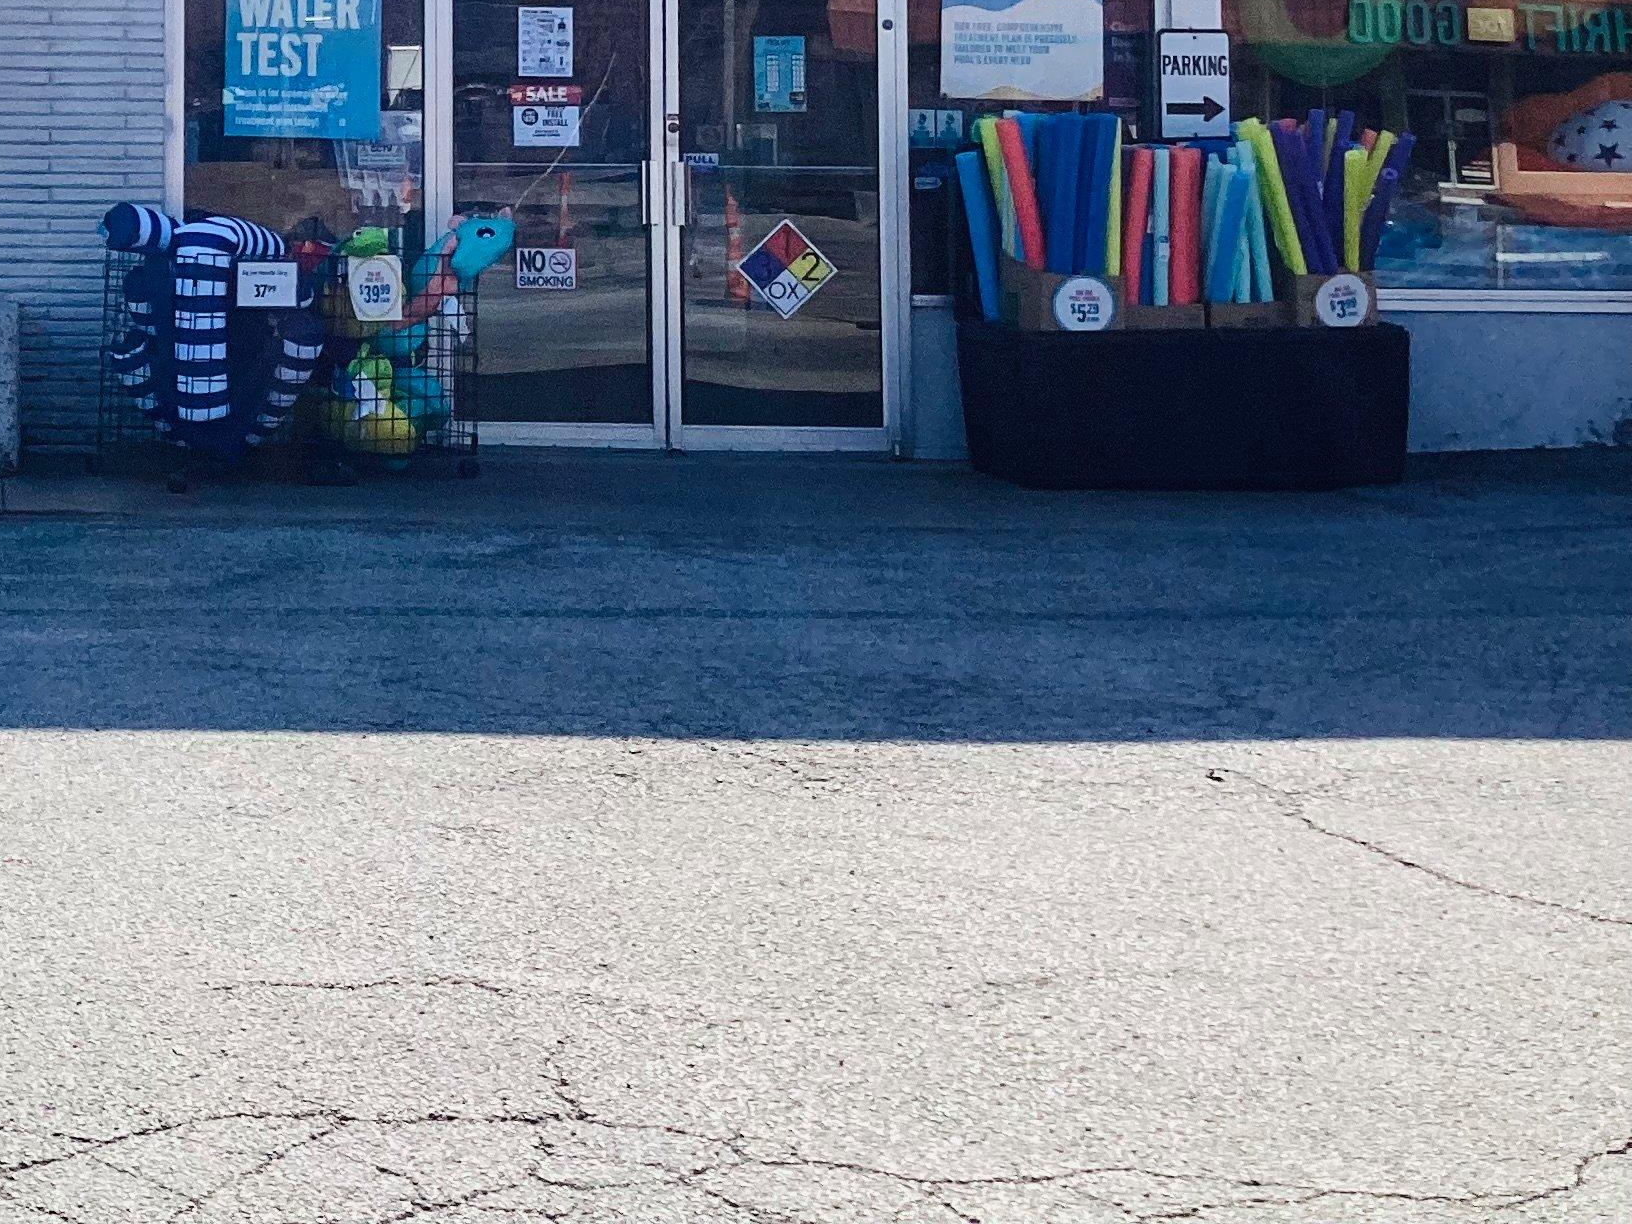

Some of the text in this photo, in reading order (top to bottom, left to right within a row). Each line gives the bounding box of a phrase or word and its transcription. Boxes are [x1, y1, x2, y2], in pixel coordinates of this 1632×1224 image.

[237, 32, 323, 77] TEST
[1162, 55, 1228, 76] PARKING
[525, 86, 568, 103] SALE
[686, 154, 716, 165] PULL
[519, 250, 546, 273] NO
[801, 251, 821, 282] 2
[519, 275, 574, 287] SMOKING
[768, 281, 800, 300] OX
